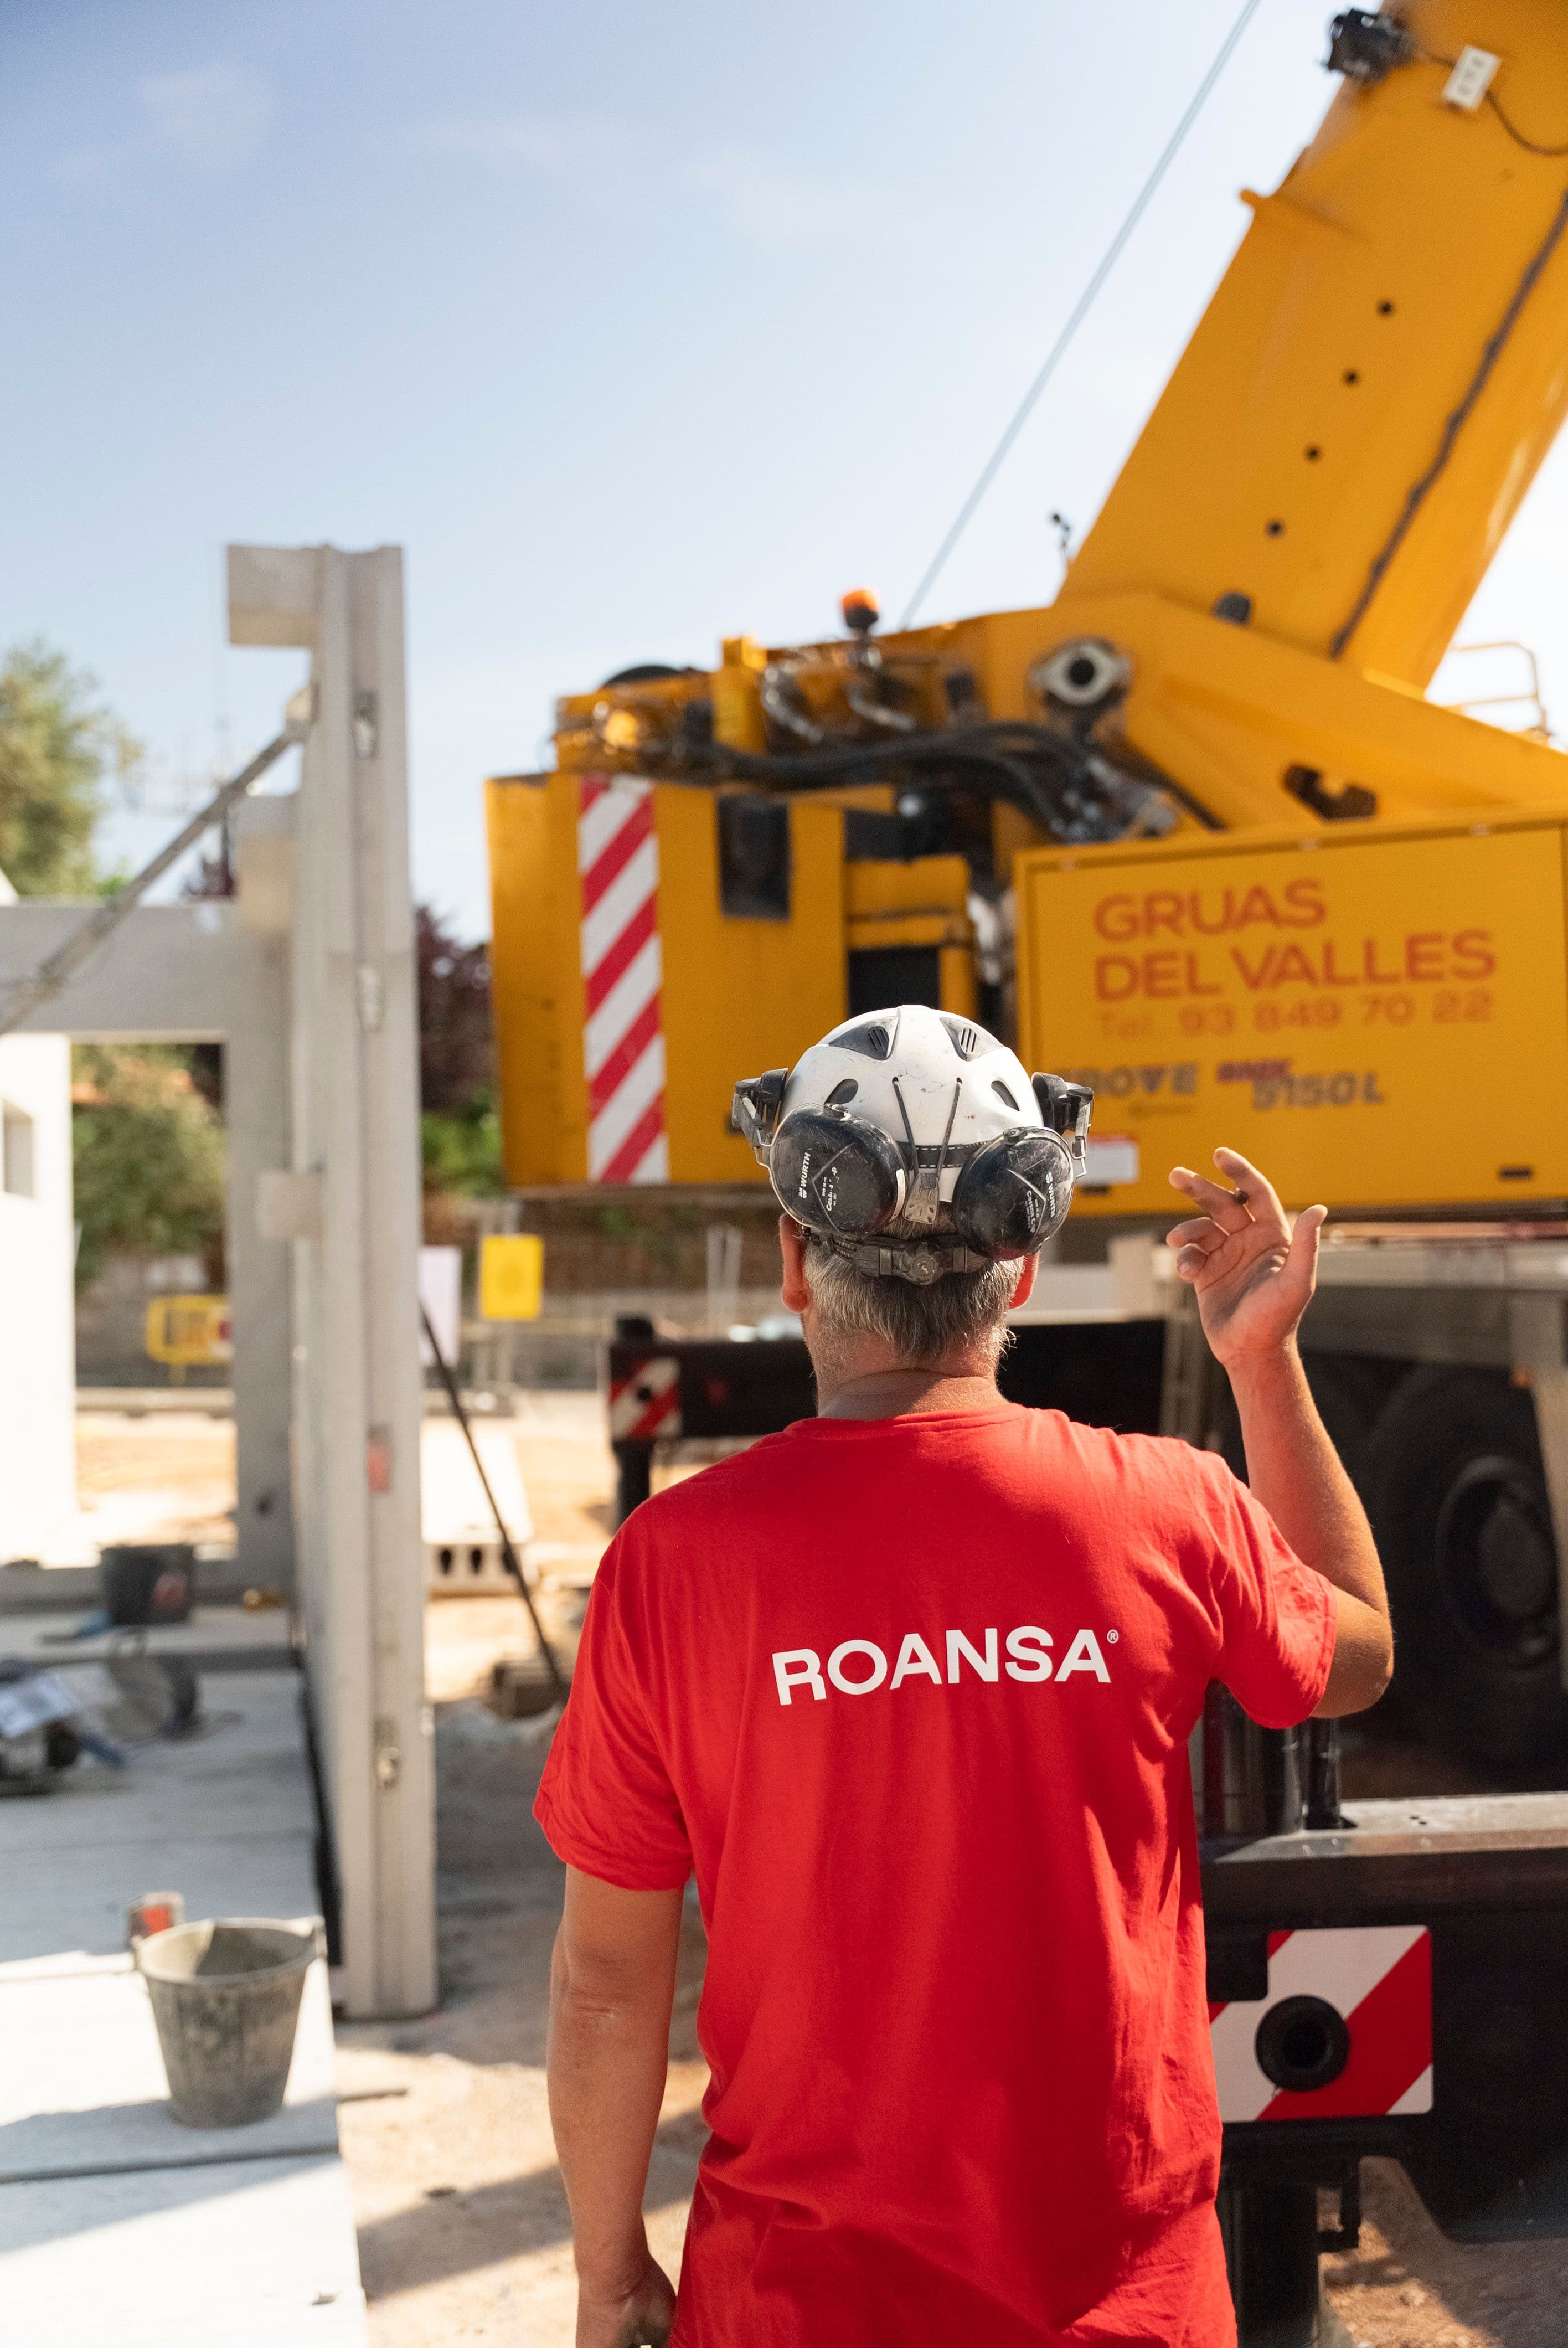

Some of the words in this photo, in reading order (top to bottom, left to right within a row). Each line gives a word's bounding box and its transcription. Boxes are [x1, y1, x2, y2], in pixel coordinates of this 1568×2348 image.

[1094, 879, 1327, 943] GRUAS
[1094, 949, 1220, 1002] DEL
[1231, 930, 1496, 991] VALLES
[1179, 1005, 1236, 1037] 93
[1254, 997, 1342, 1033] 849
[1360, 992, 1416, 1027] 70
[1432, 988, 1493, 1023] 22
